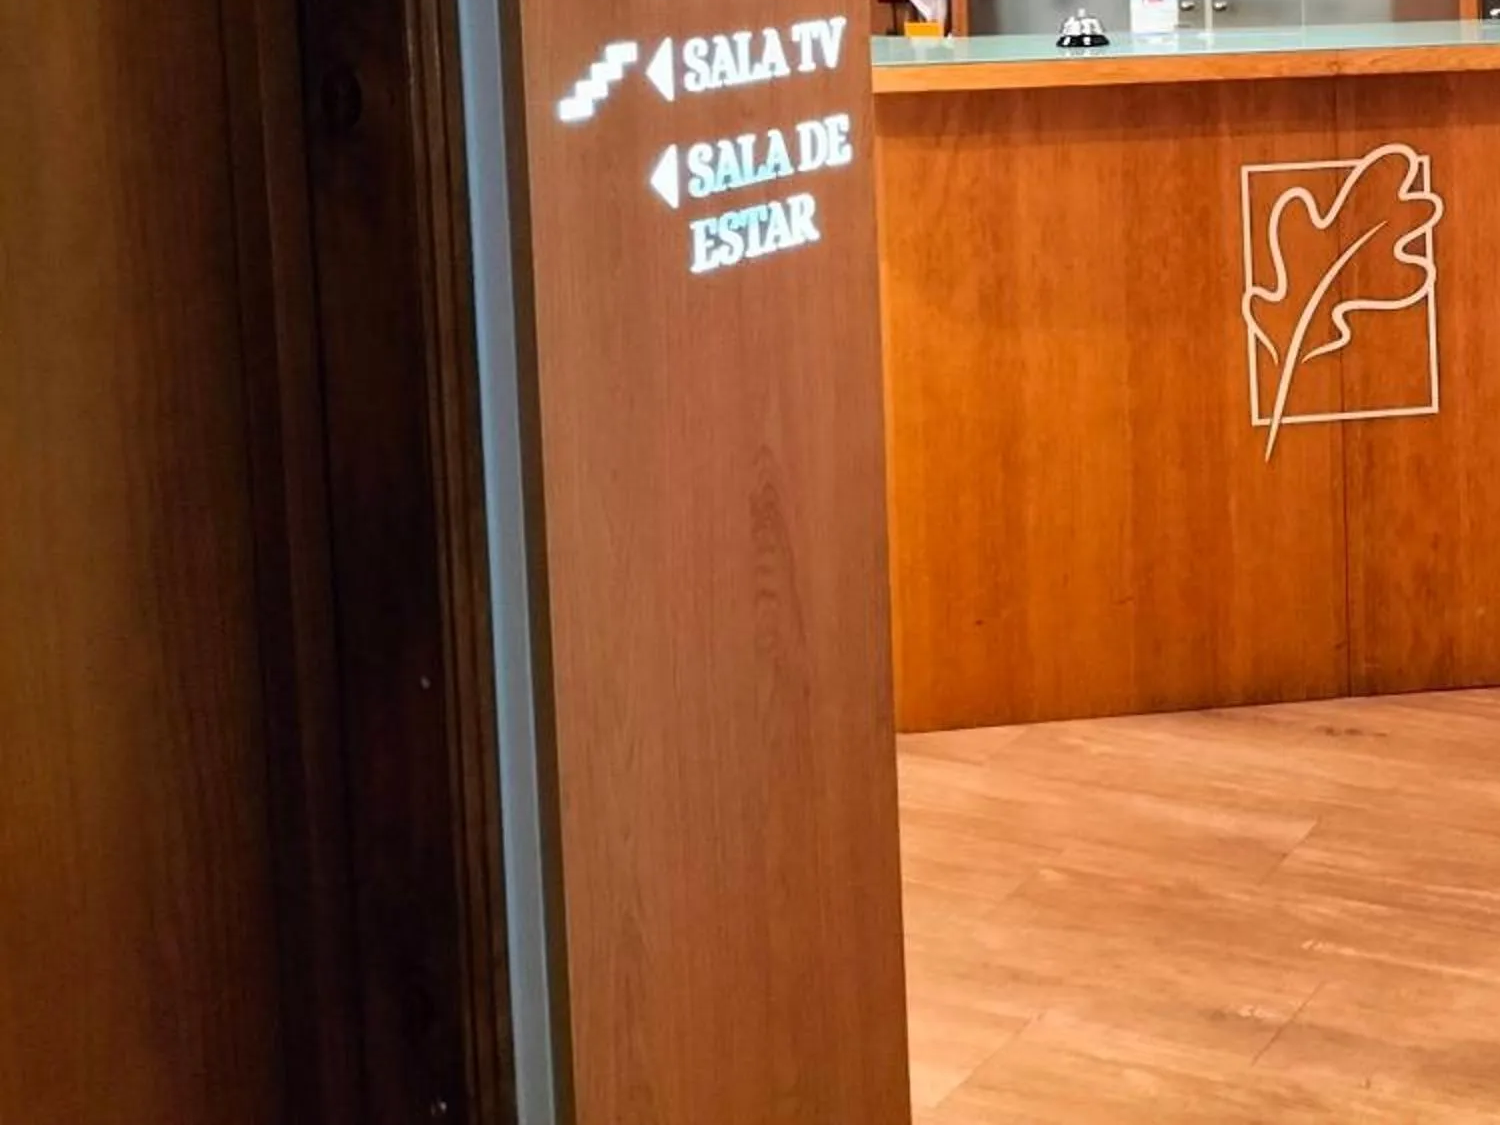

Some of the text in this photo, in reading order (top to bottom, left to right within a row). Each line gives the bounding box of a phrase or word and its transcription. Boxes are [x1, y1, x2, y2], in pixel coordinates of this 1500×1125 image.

[683, 15, 847, 92] SALA TV
[687, 113, 852, 198] SALA DE
[689, 192, 820, 274] ESTAR
